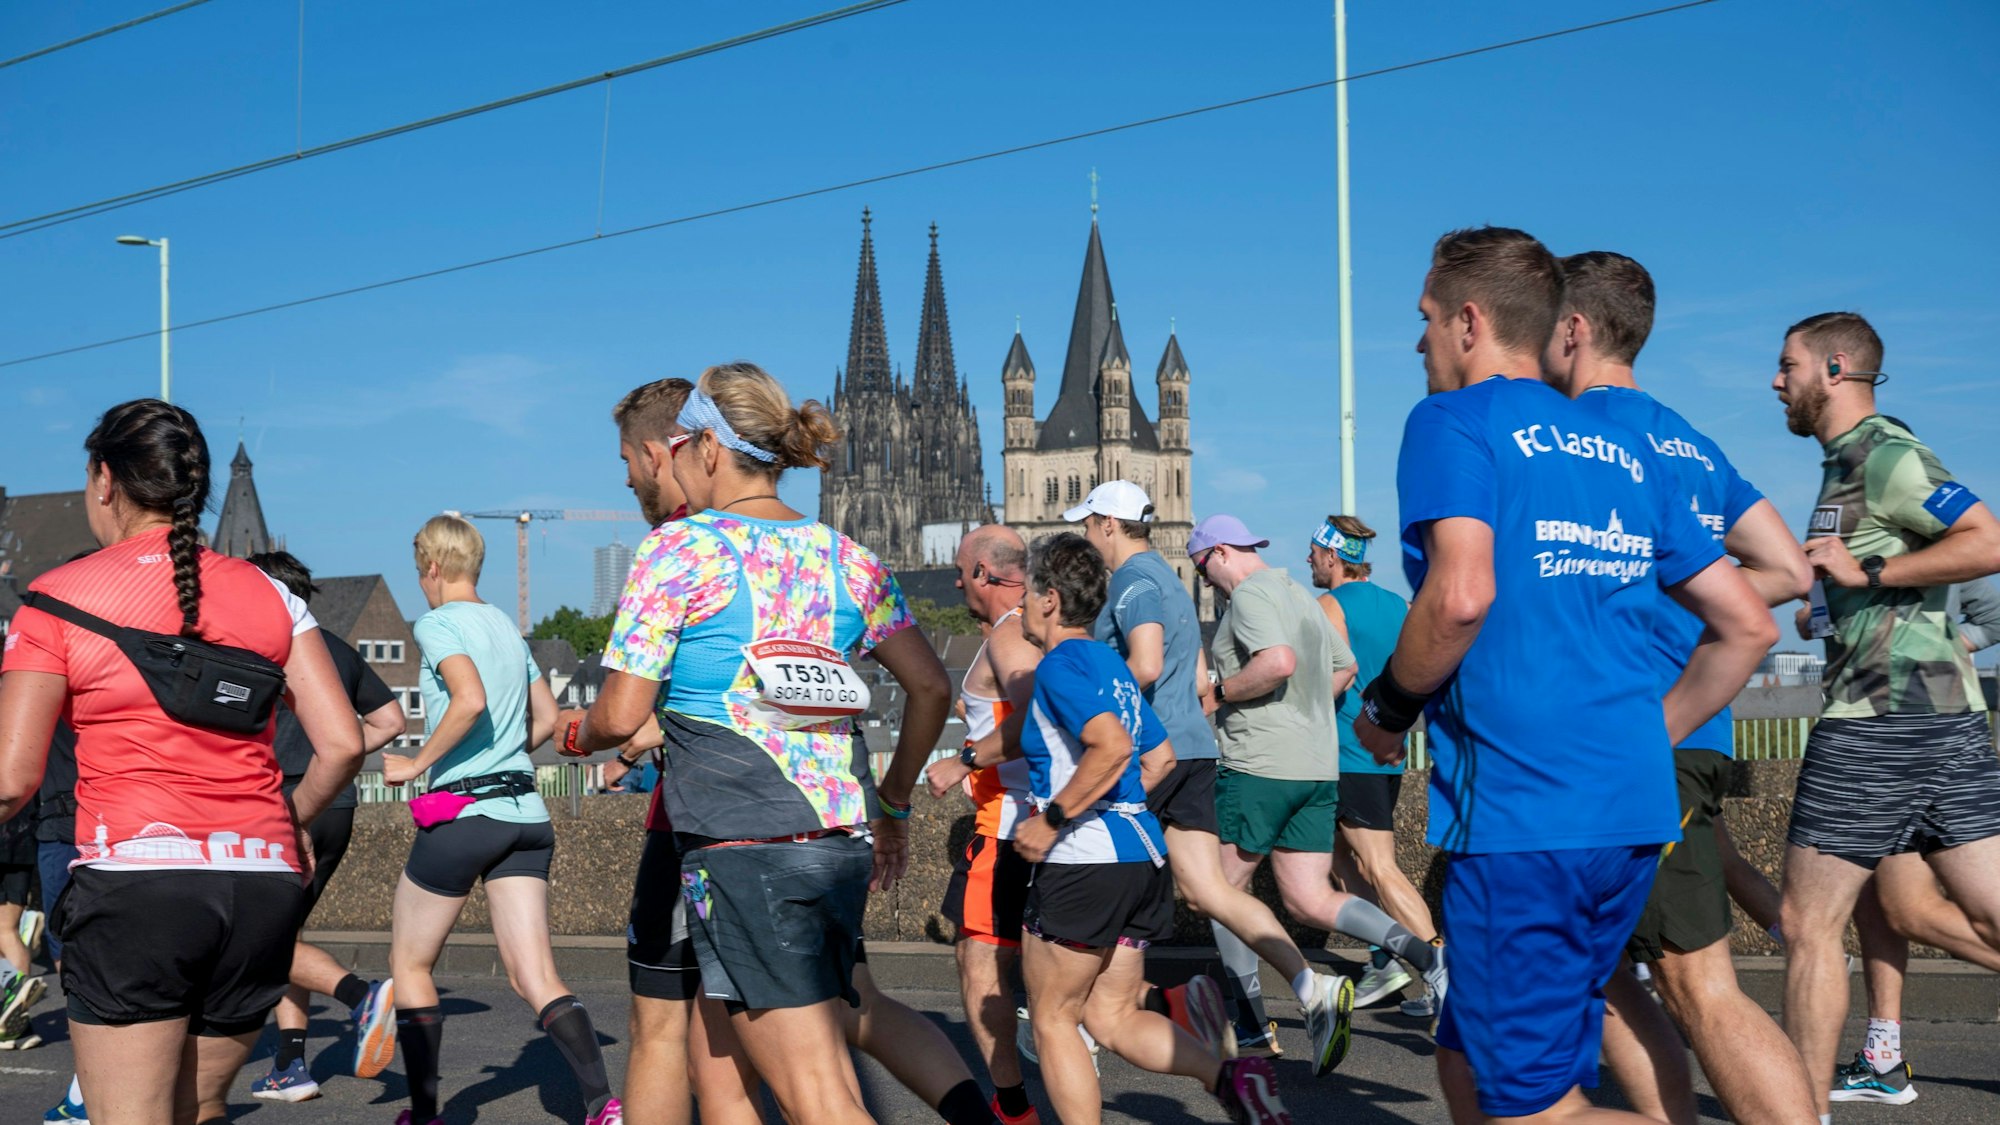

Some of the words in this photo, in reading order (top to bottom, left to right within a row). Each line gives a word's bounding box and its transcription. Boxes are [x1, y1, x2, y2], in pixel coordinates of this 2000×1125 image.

[1512, 424, 1553, 458] FC
[137, 553, 163, 564] SEIT
[774, 686, 812, 700] SOFA
[816, 688, 834, 702] TO
[838, 689, 858, 703] GO
